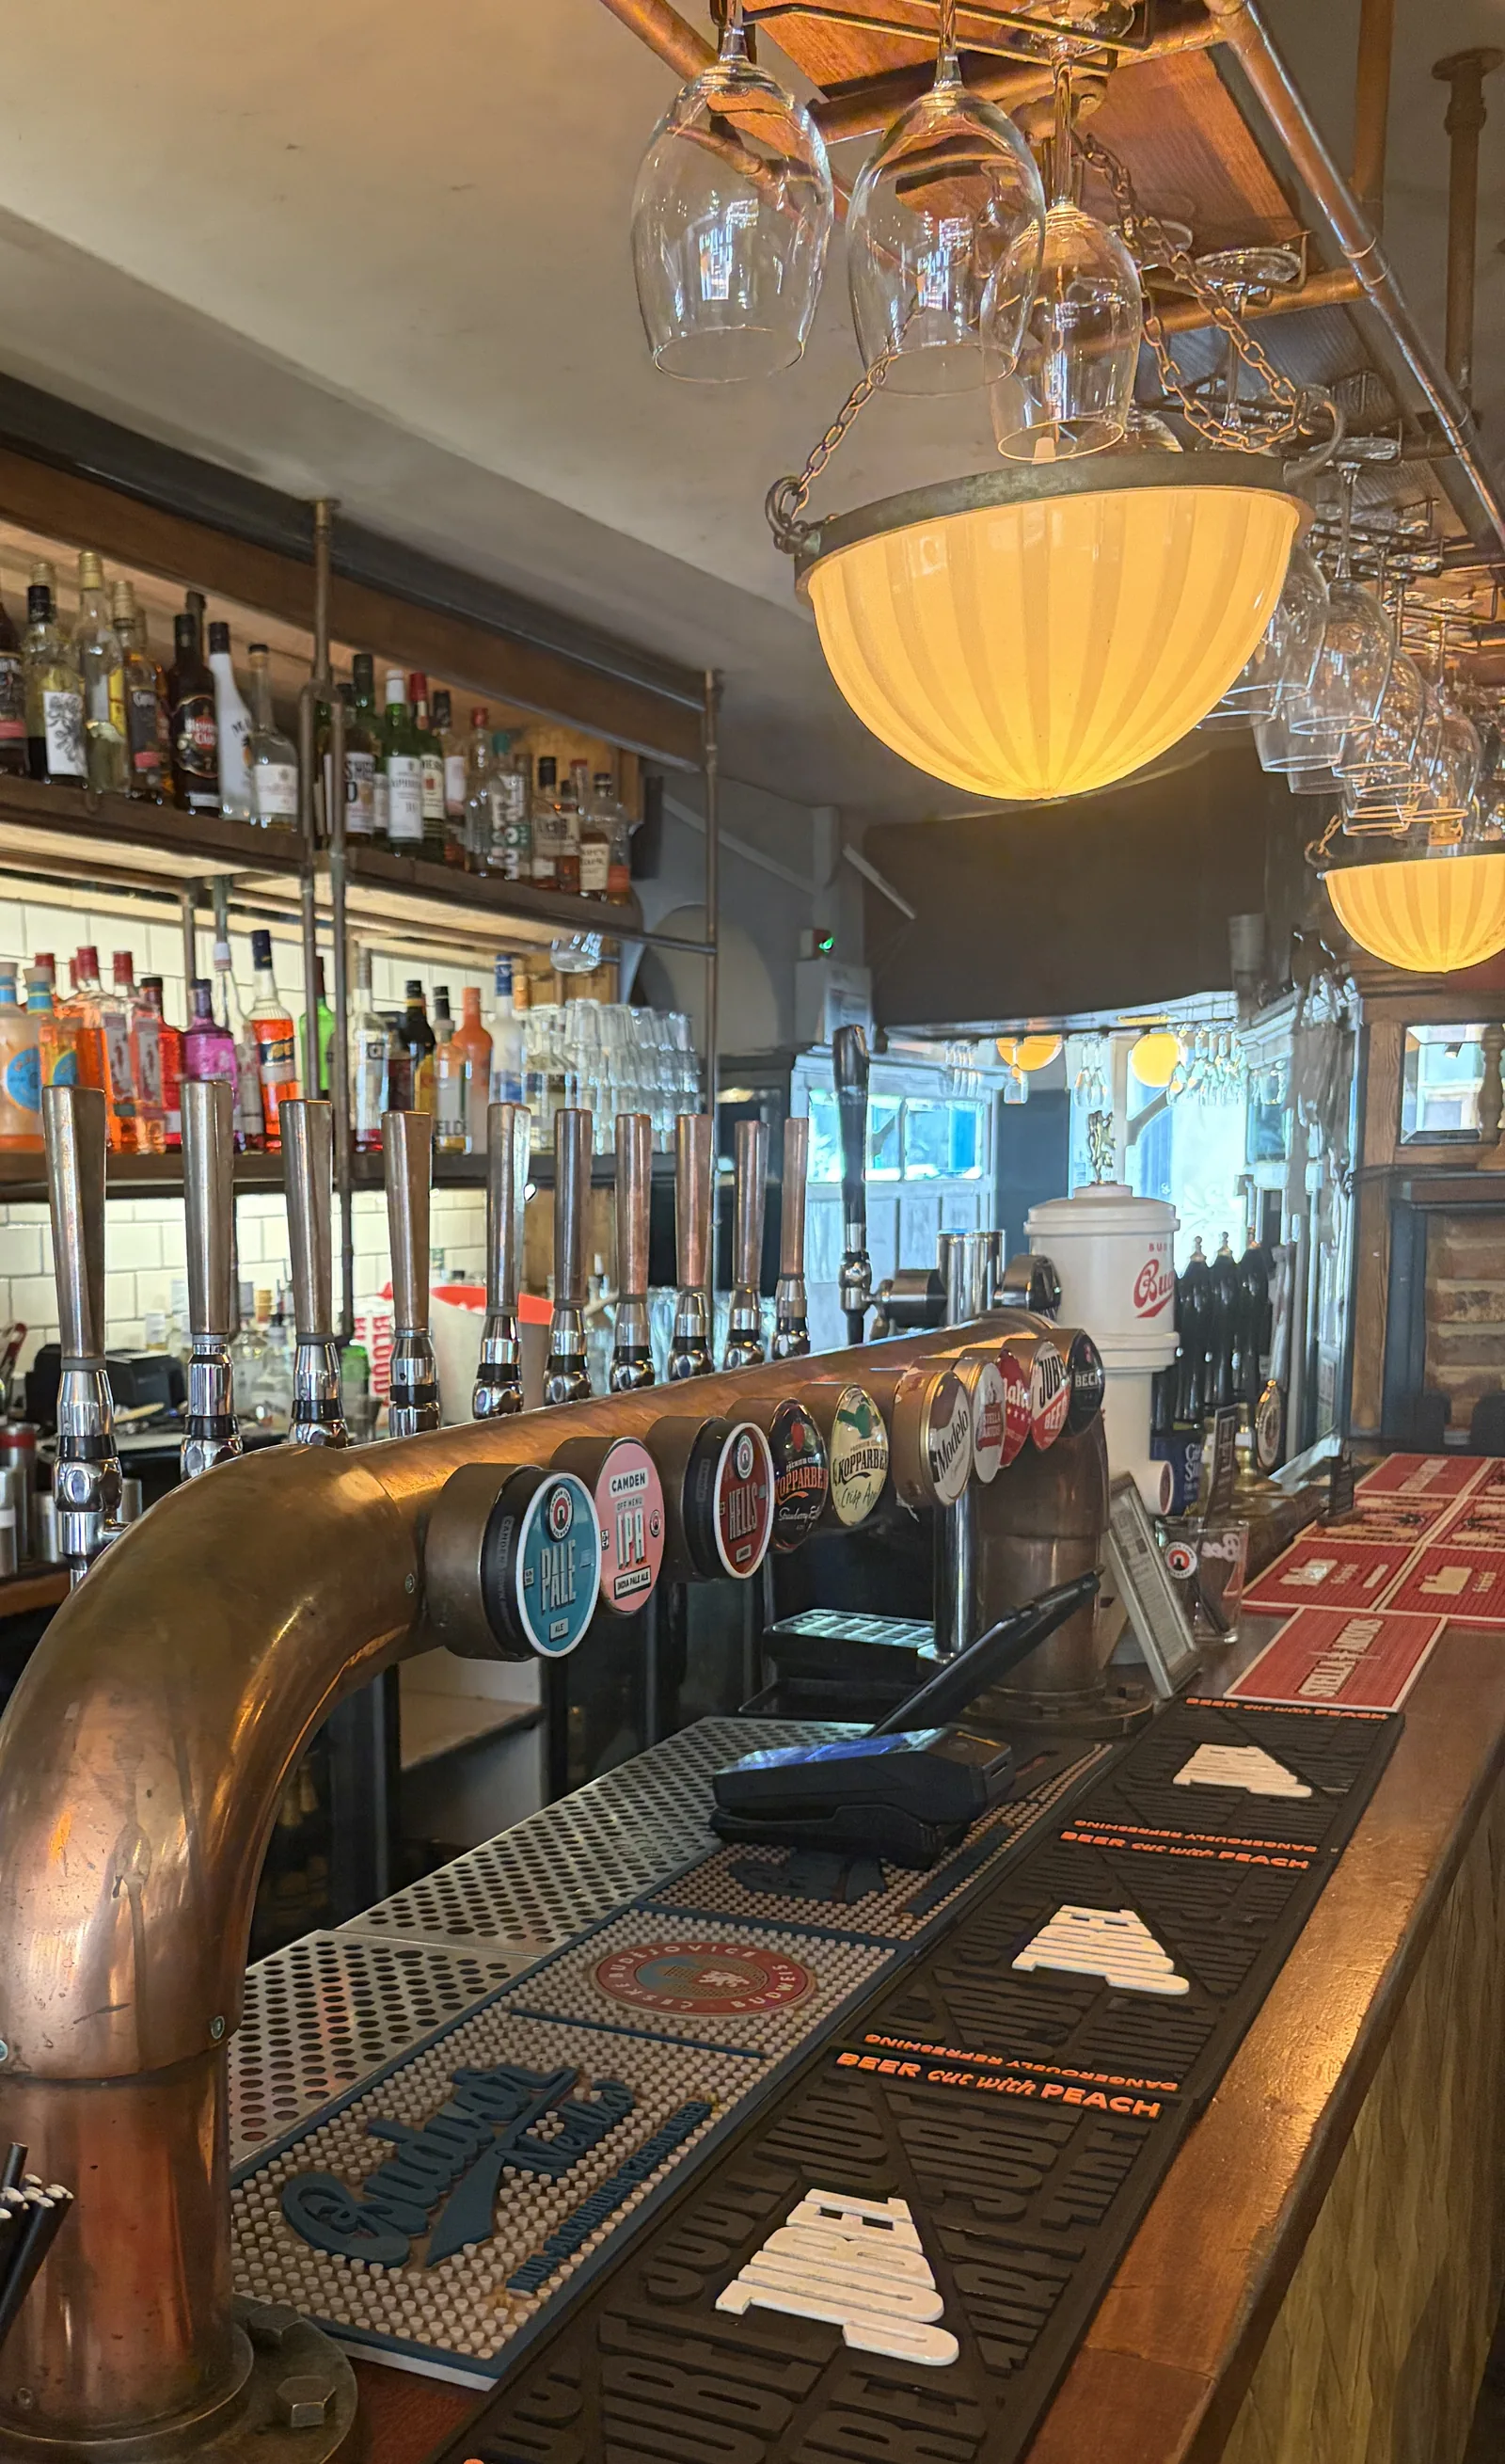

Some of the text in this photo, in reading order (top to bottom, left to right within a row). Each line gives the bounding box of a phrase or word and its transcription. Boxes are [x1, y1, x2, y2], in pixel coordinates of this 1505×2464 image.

[838, 1449, 888, 1485] KOPPARBE
[936, 1409, 969, 1479] Modelo
[611, 1471, 645, 1492] CAMDEN
[617, 1501, 627, 1510] OFF
[729, 1482, 758, 1540] HELLS
[616, 1508, 645, 1570] IPA
[541, 1539, 577, 1612] PALE
[617, 1571, 649, 1591] INDIA PALE ALE
[554, 1622, 564, 1634] ALE
[1314, 1709, 1389, 1721] PEACH
[1060, 1831, 1309, 1869] BEER cut with PEACH
[835, 2052, 1162, 2119] BEER cut with PEACH
[863, 2033, 1179, 2092] DANGEROUSLY REFRESHING
[662, 2100, 713, 2141] LAGER
[283, 2064, 564, 2268] Budvar
[715, 2187, 959, 2366] JUBEL
